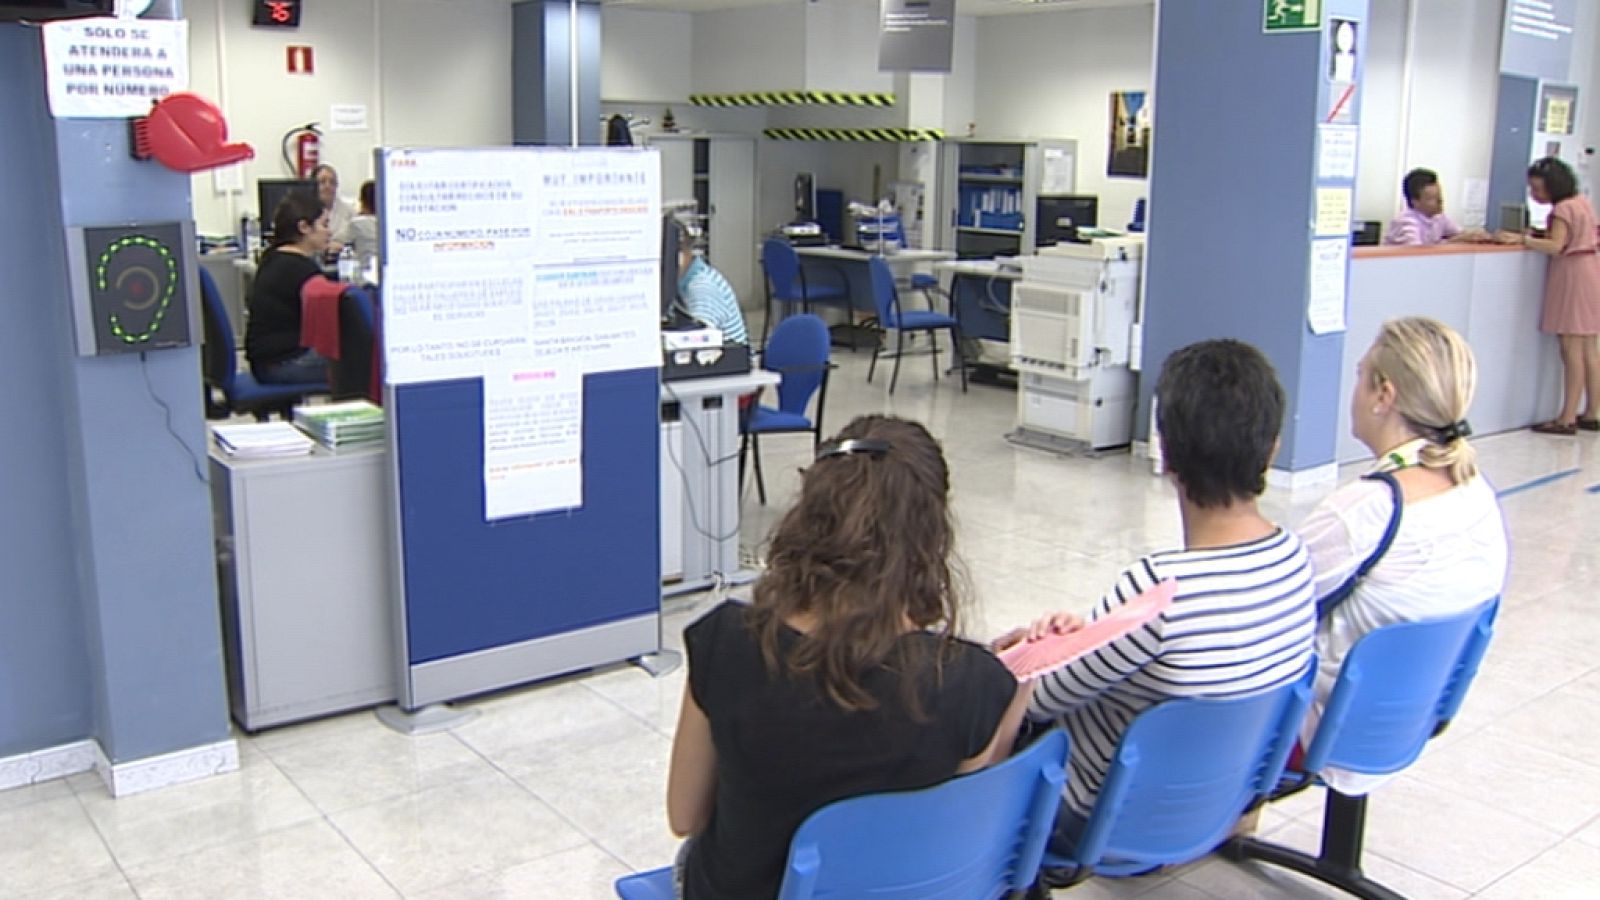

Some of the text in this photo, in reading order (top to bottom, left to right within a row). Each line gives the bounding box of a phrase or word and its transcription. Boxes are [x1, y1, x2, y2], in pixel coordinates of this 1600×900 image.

[131, 29, 151, 40] SE
[157, 48, 168, 60] A
[62, 63, 175, 79] UNA PERSONA
[65, 82, 99, 96] POR
[395, 227, 417, 243] NO
